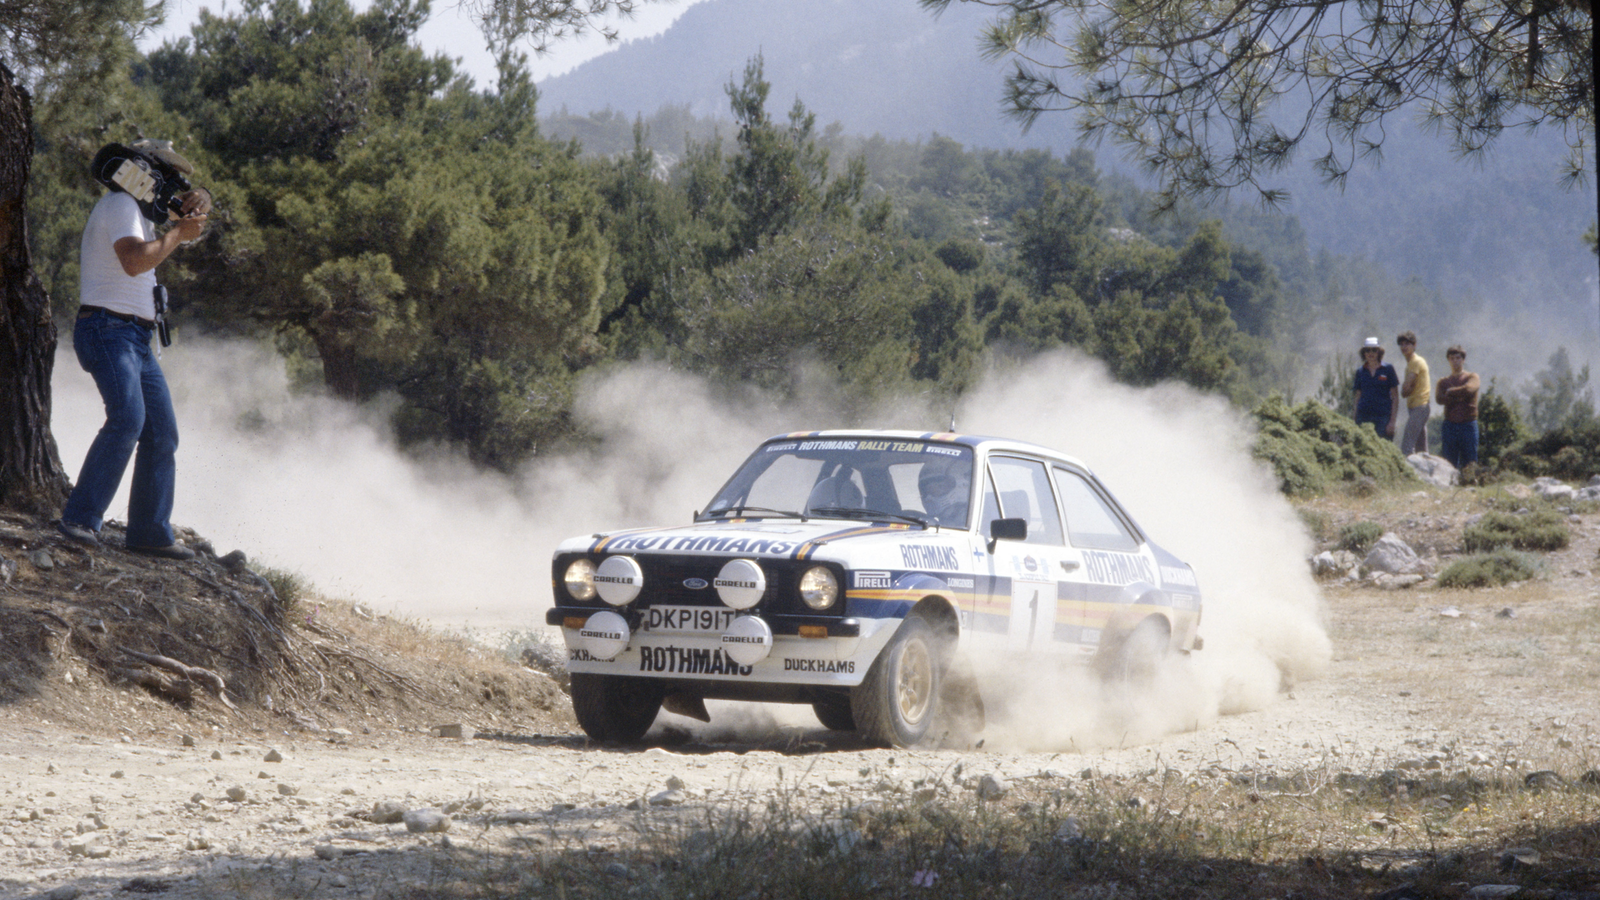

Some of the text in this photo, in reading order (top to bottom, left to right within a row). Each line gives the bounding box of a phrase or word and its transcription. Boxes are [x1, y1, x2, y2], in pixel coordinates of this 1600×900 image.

[799, 441, 924, 453] ROTHMANS RALLY TEAM
[614, 536, 799, 554] ROTHMANS
[900, 544, 959, 571] ROTHMANS
[1081, 551, 1155, 586] ROTHMANS
[593, 575, 634, 584] CARELLO
[715, 580, 756, 588] CARELLO
[854, 571, 891, 588] PIRELLI
[1029, 590, 1039, 651] 1
[581, 630, 621, 639] CARELLO
[722, 636, 763, 644] CARELLO
[784, 659, 855, 674] DUCKHAMS
